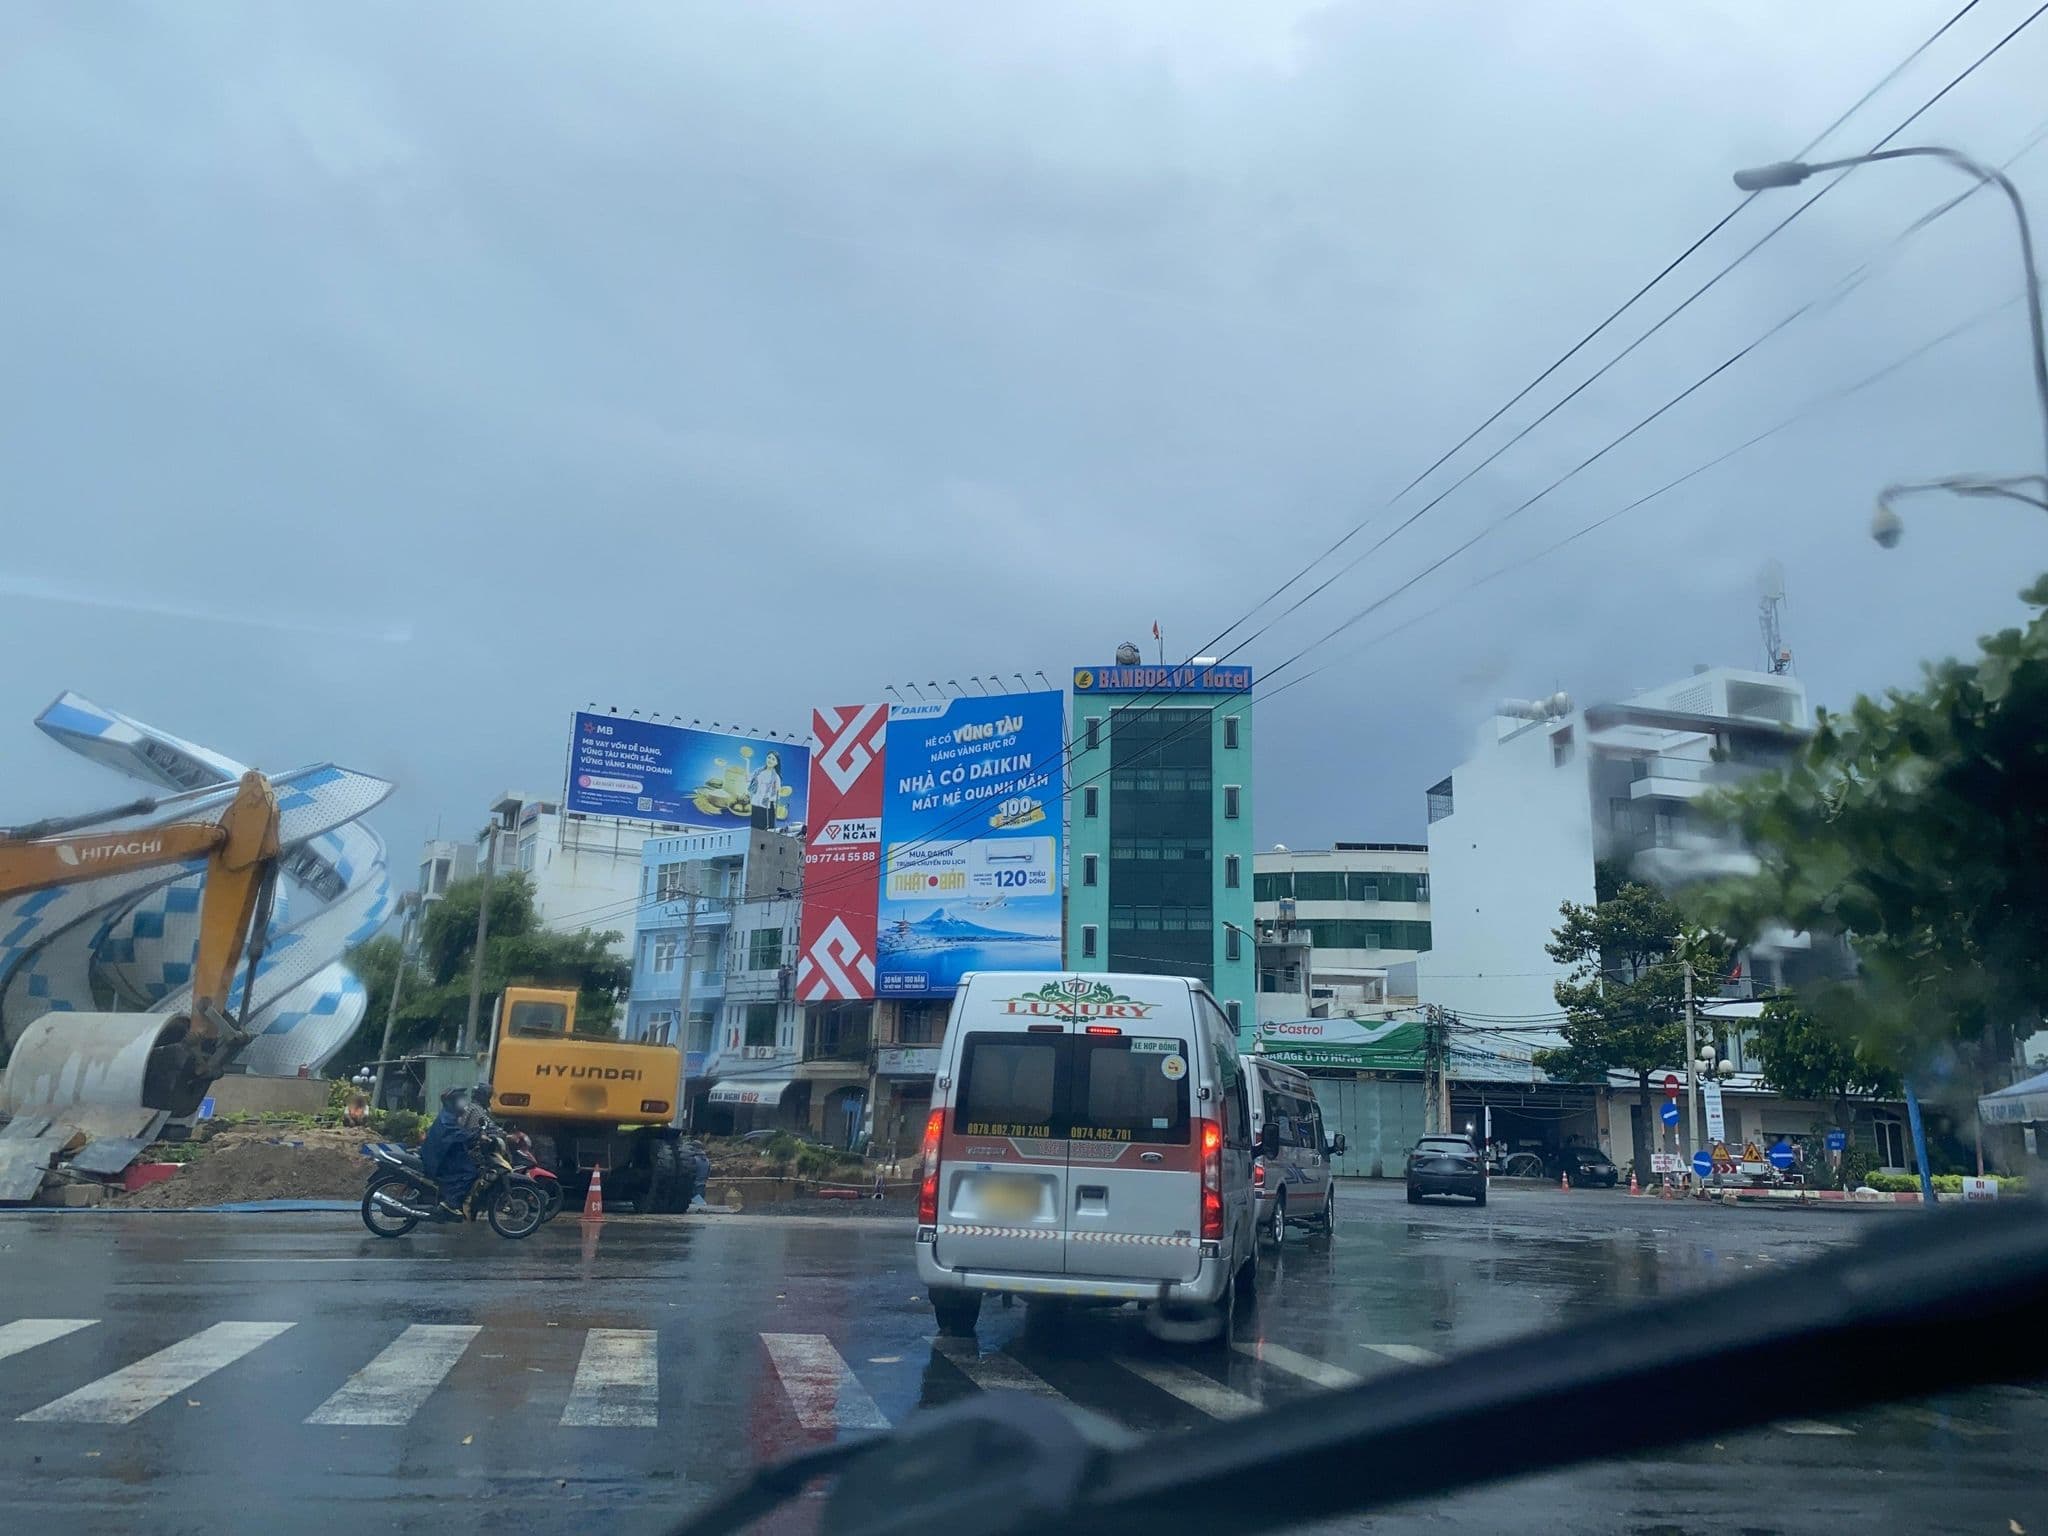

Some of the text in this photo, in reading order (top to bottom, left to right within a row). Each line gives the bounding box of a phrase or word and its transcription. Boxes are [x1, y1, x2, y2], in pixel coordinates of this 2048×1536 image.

[1098, 668, 1249, 688] BAMBOO.VN Hotel
[901, 705, 942, 715] DAIKIN
[596, 725, 614, 735] MB
[938, 734, 951, 745] CÓ
[953, 723, 994, 744] VŨNG
[995, 715, 1024, 735] TÀU
[582, 738, 594, 746] MB
[595, 740, 610, 748] VAY
[957, 743, 982, 756] VÀNG
[581, 747, 603, 756] VŨNG
[604, 750, 619, 758] TÀU
[626, 762, 645, 771] KINH
[645, 766, 673, 775] DOANH
[899, 753, 1032, 793] NHÀ CÓ DAIKIN
[912, 792, 940, 811] MÁT
[965, 780, 1014, 801] QUANH
[1017, 773, 1049, 792] NĂM
[999, 796, 1032, 818] 100
[843, 823, 865, 831] KIM
[843, 831, 876, 840] NGAN
[82, 841, 161, 860] HITACHI
[909, 849, 953, 858] MUA DAIKIN
[805, 851, 875, 864] 09 77 44 55 88
[951, 859, 966, 867] LỊCH
[895, 872, 928, 893] NHẬT
[994, 870, 1027, 888] 120
[1008, 1003, 1153, 1018] LUXURY
[1279, 1023, 1324, 1036] Castrol
[536, 1064, 642, 1081] HYUNDAI
[741, 1091, 759, 1103] 602
[1028, 1125, 1050, 1138] ZALO
